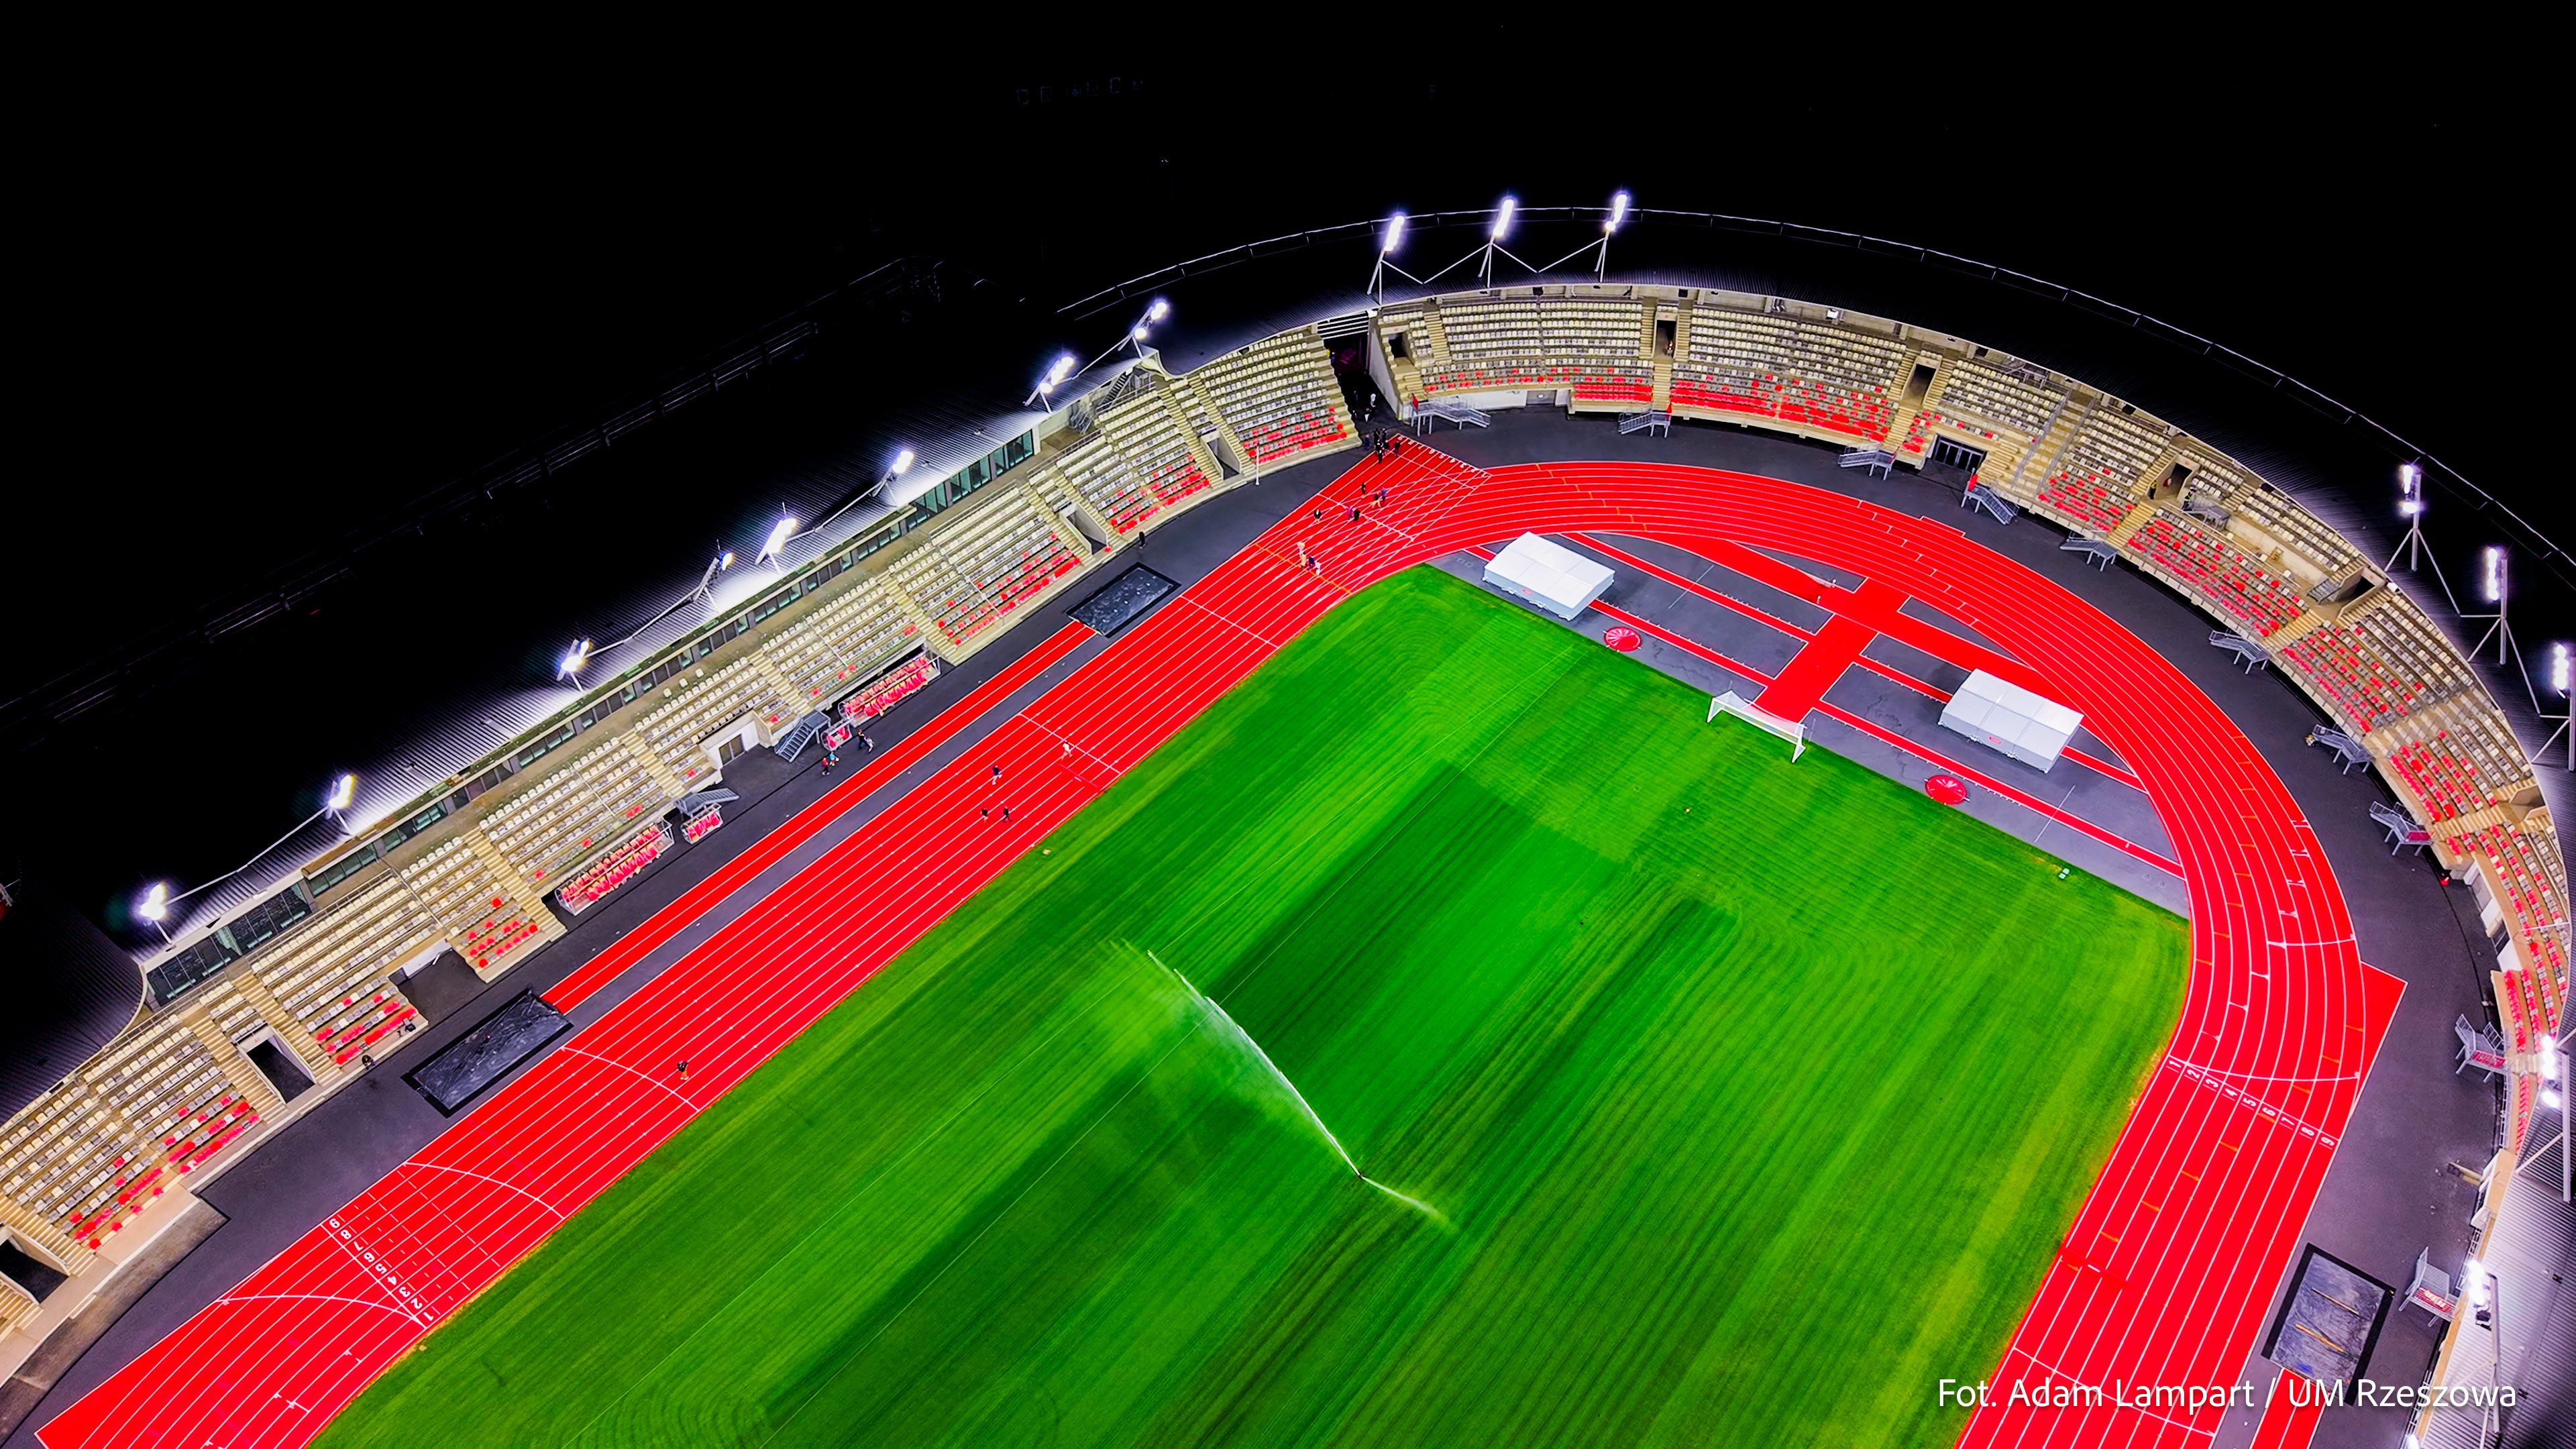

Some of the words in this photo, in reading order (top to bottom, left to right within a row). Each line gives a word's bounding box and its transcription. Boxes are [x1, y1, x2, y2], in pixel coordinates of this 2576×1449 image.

[2169, 1060, 2182, 1068] 1
[2187, 1069, 2200, 1079] 2
[2206, 1079, 2219, 1087] 3
[2224, 1088, 2238, 1097] 4
[2243, 1097, 2257, 1107] 5
[2262, 1107, 2276, 1117] 6
[2282, 1117, 2295, 1126] 7
[2301, 1126, 2315, 1136] 8
[2320, 1136, 2334, 1146] 9
[329, 1218, 340, 1228] 9
[340, 1229, 352, 1240] 8
[354, 1241, 364, 1251] 7
[364, 1252, 375, 1263] 6
[375, 1263, 387, 1274] 5
[387, 1276, 397, 1285] 4
[399, 1287, 411, 1297] 3
[411, 1298, 423, 1309] 2
[423, 1312, 434, 1321] 1
